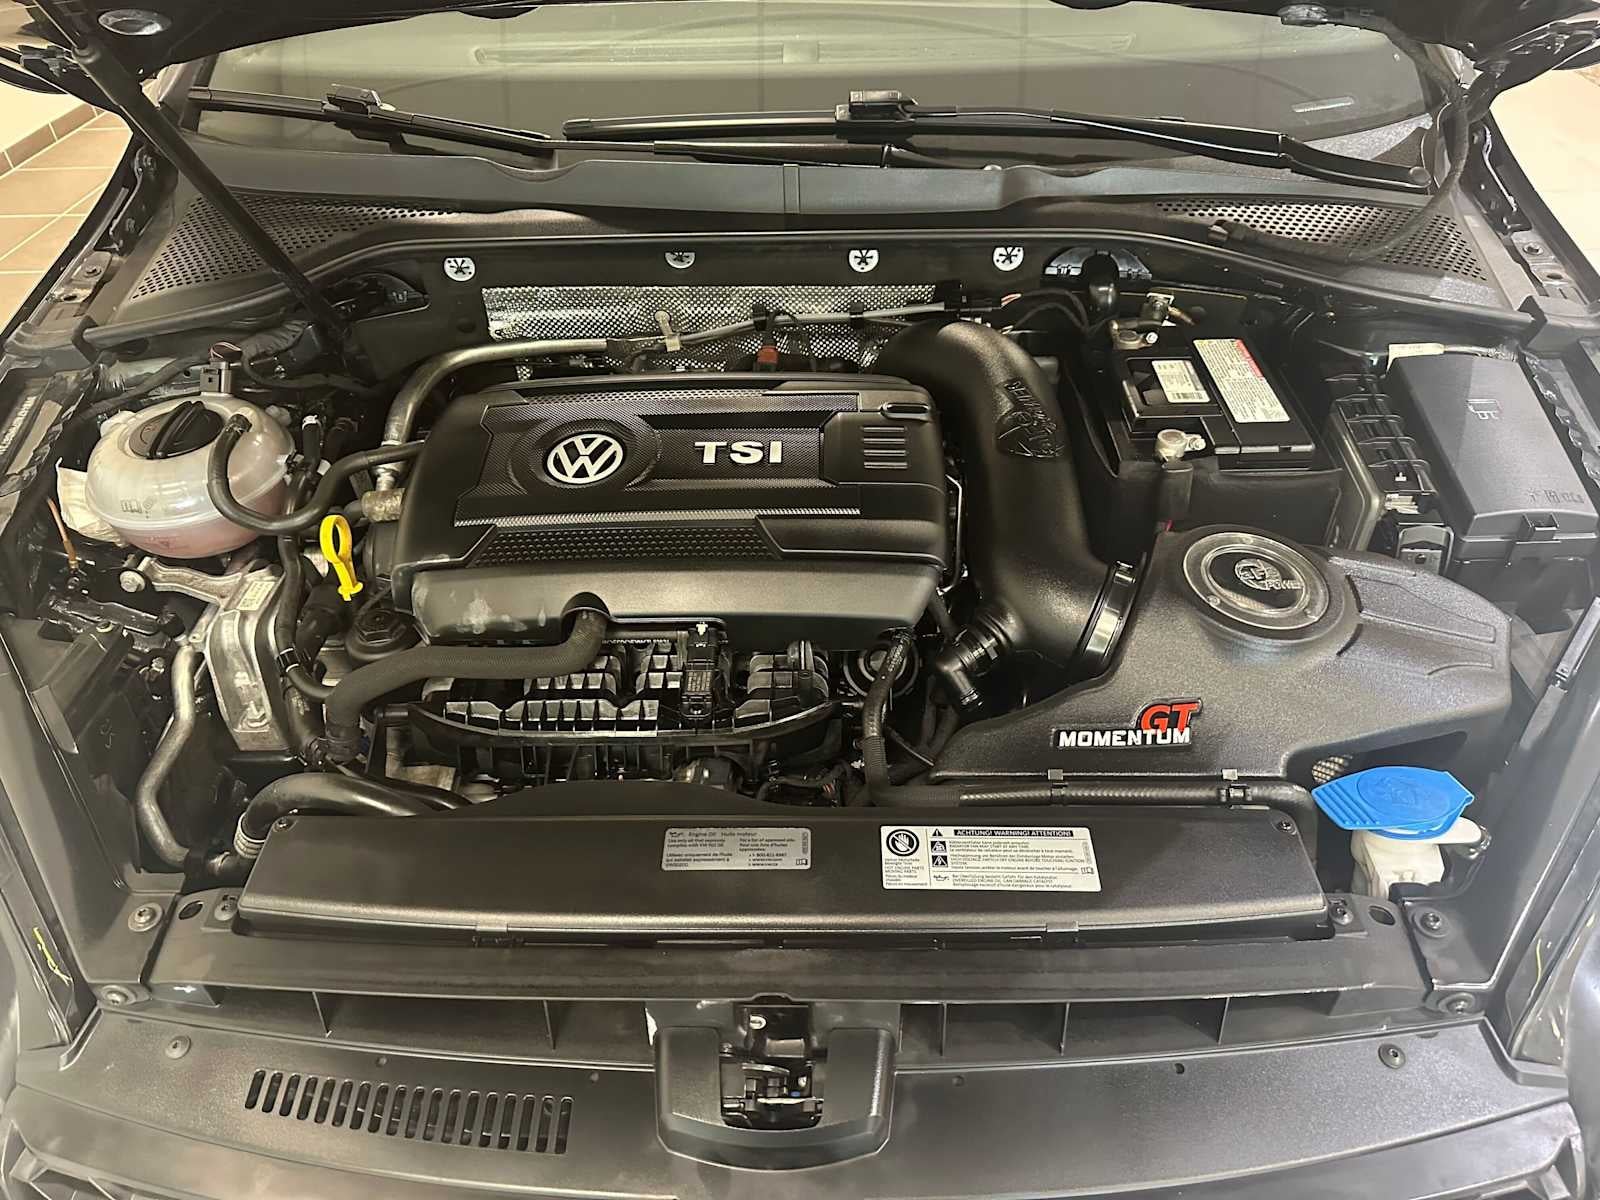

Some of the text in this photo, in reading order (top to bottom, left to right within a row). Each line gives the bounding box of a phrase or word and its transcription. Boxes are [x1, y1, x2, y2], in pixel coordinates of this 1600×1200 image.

[547, 433, 624, 484] VW
[694, 440, 783, 465] TSI
[1141, 702, 1199, 733] GT
[1058, 727, 1191, 748] MOMENTUM
[956, 829, 1072, 838] ACHTUNG! WARNING! ATTENTION!
